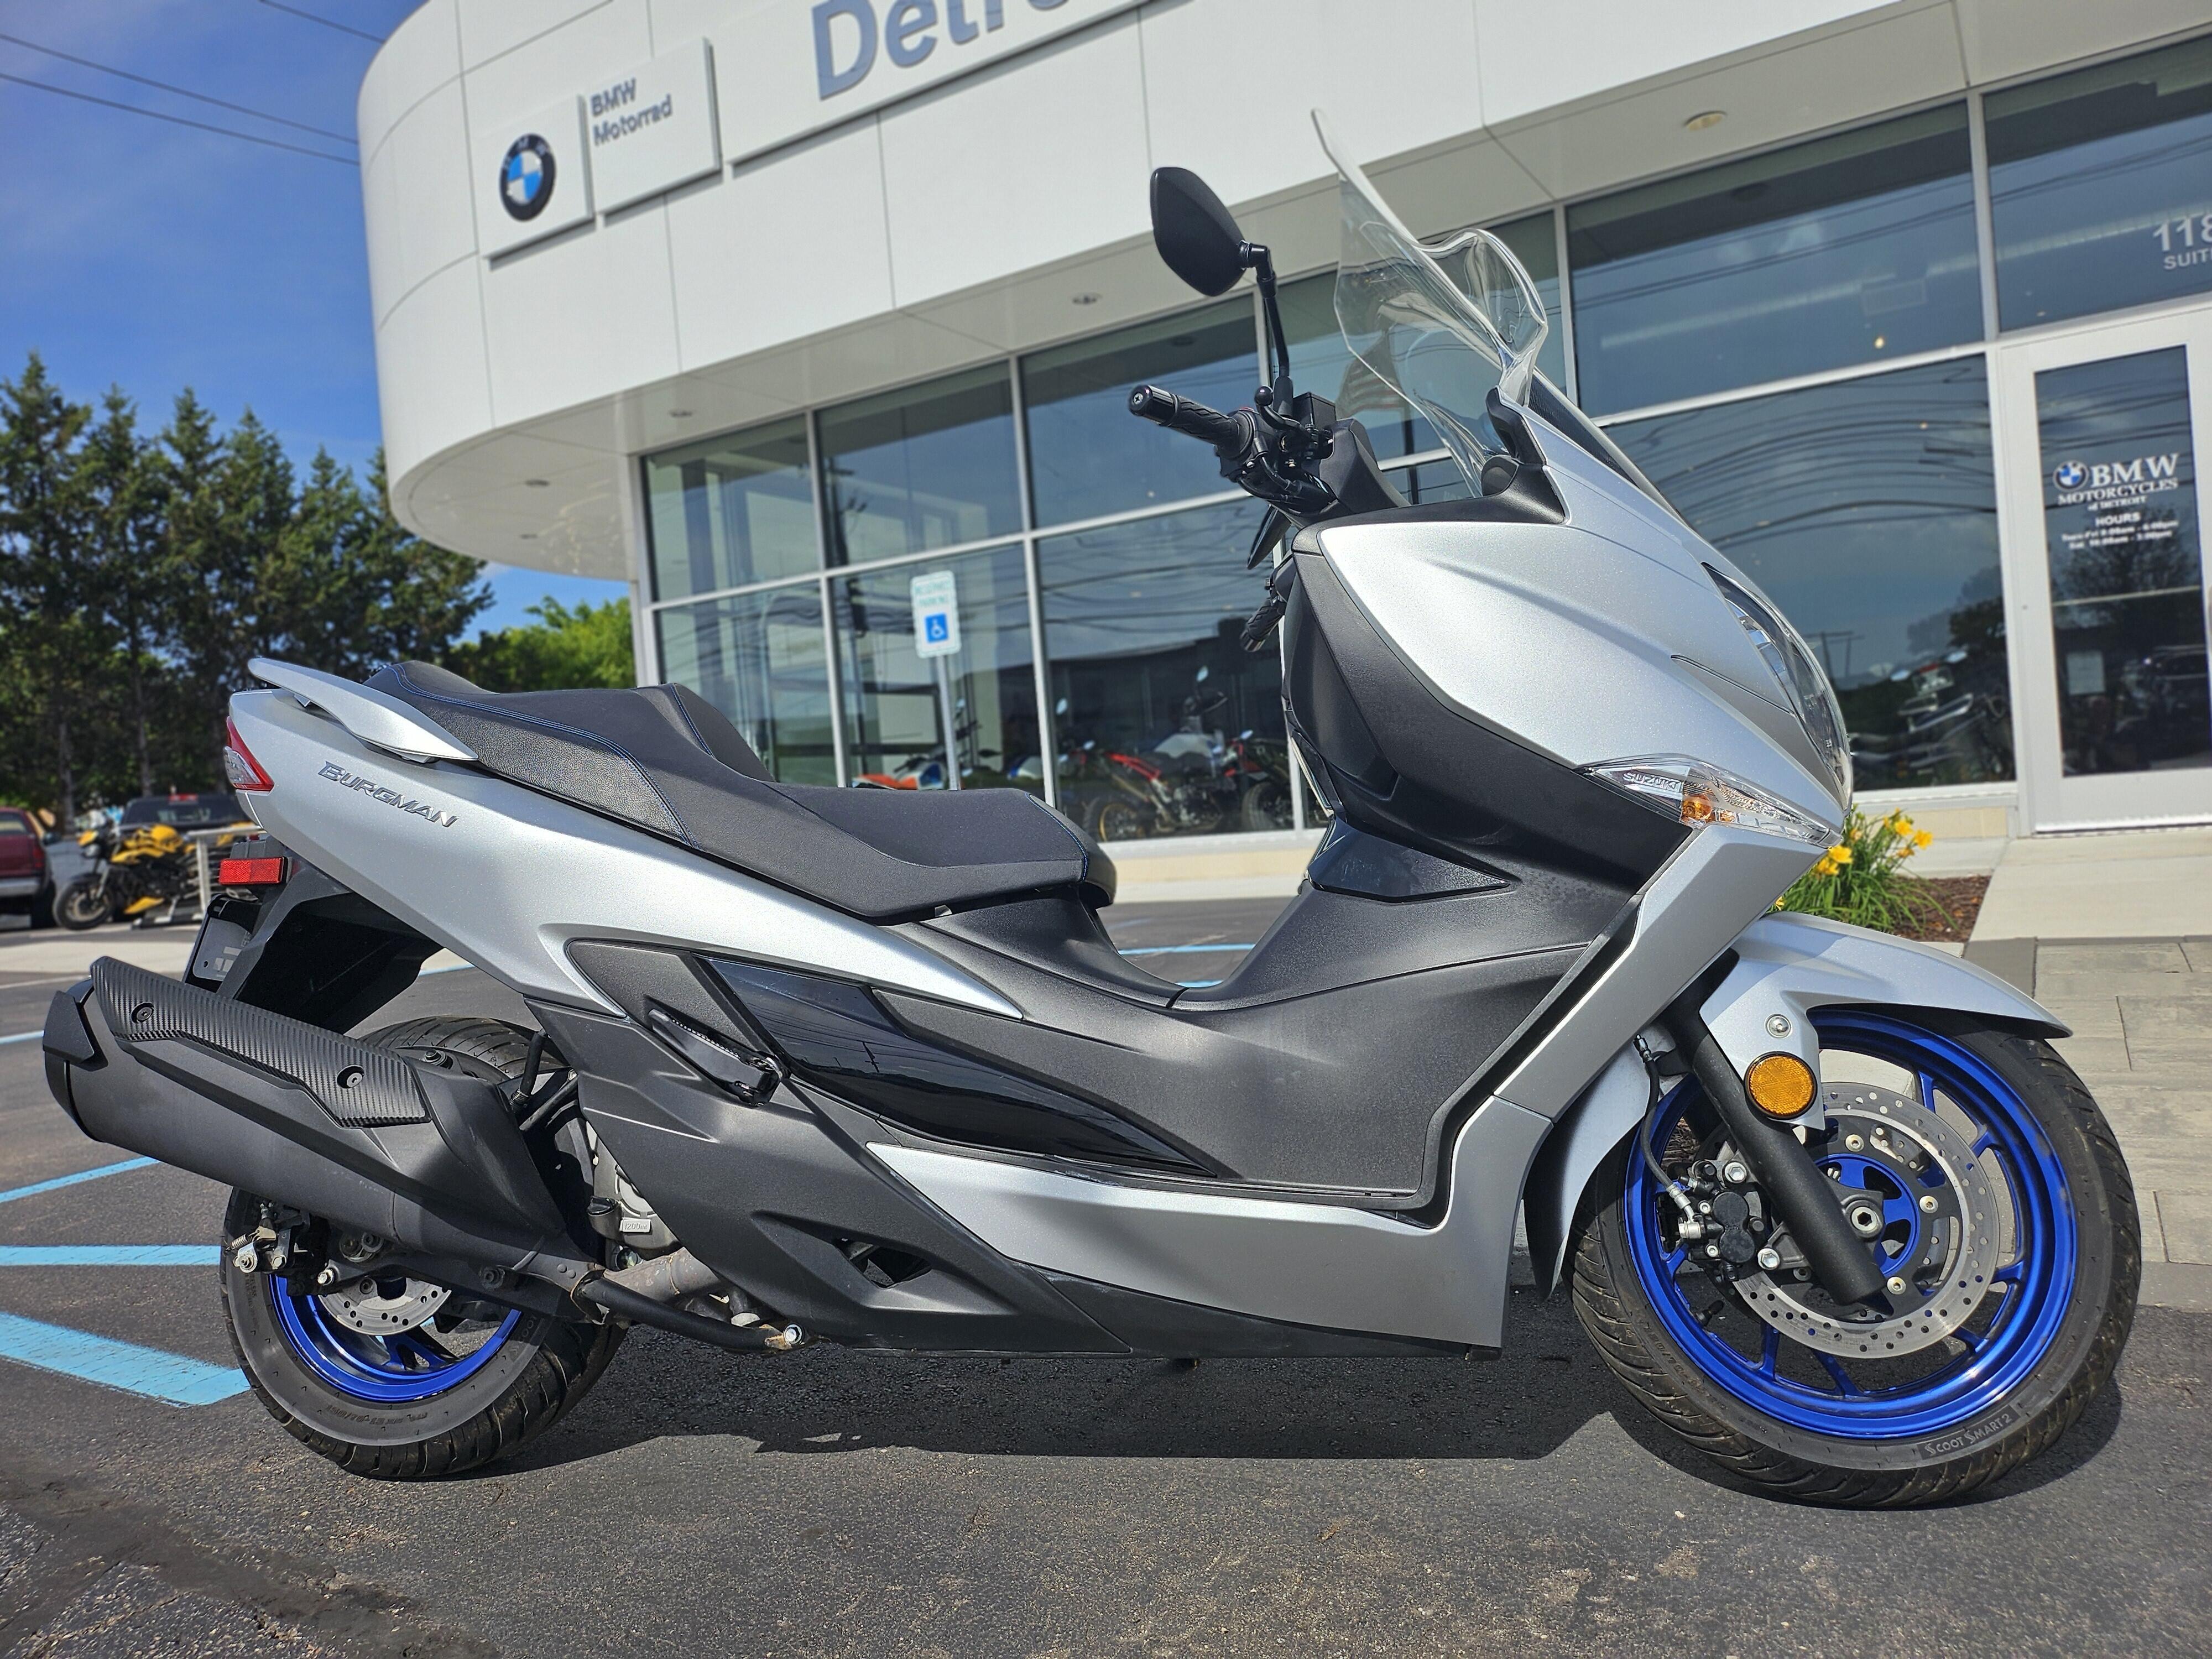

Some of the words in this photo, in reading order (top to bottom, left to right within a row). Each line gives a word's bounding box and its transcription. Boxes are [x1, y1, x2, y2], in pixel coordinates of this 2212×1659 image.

[591, 77, 636, 117] BMW
[593, 93, 672, 147] Motorrad
[2163, 248, 2212, 270] SUIT
[2090, 453, 2178, 488] BMW
[2058, 477, 2178, 505] MOTORCYCLES
[2095, 512, 2141, 527] HOURS
[318, 760, 459, 827] BURGMAN
[1623, 772, 1682, 792] SUZUKI
[2001, 1413, 2013, 1423] 2
